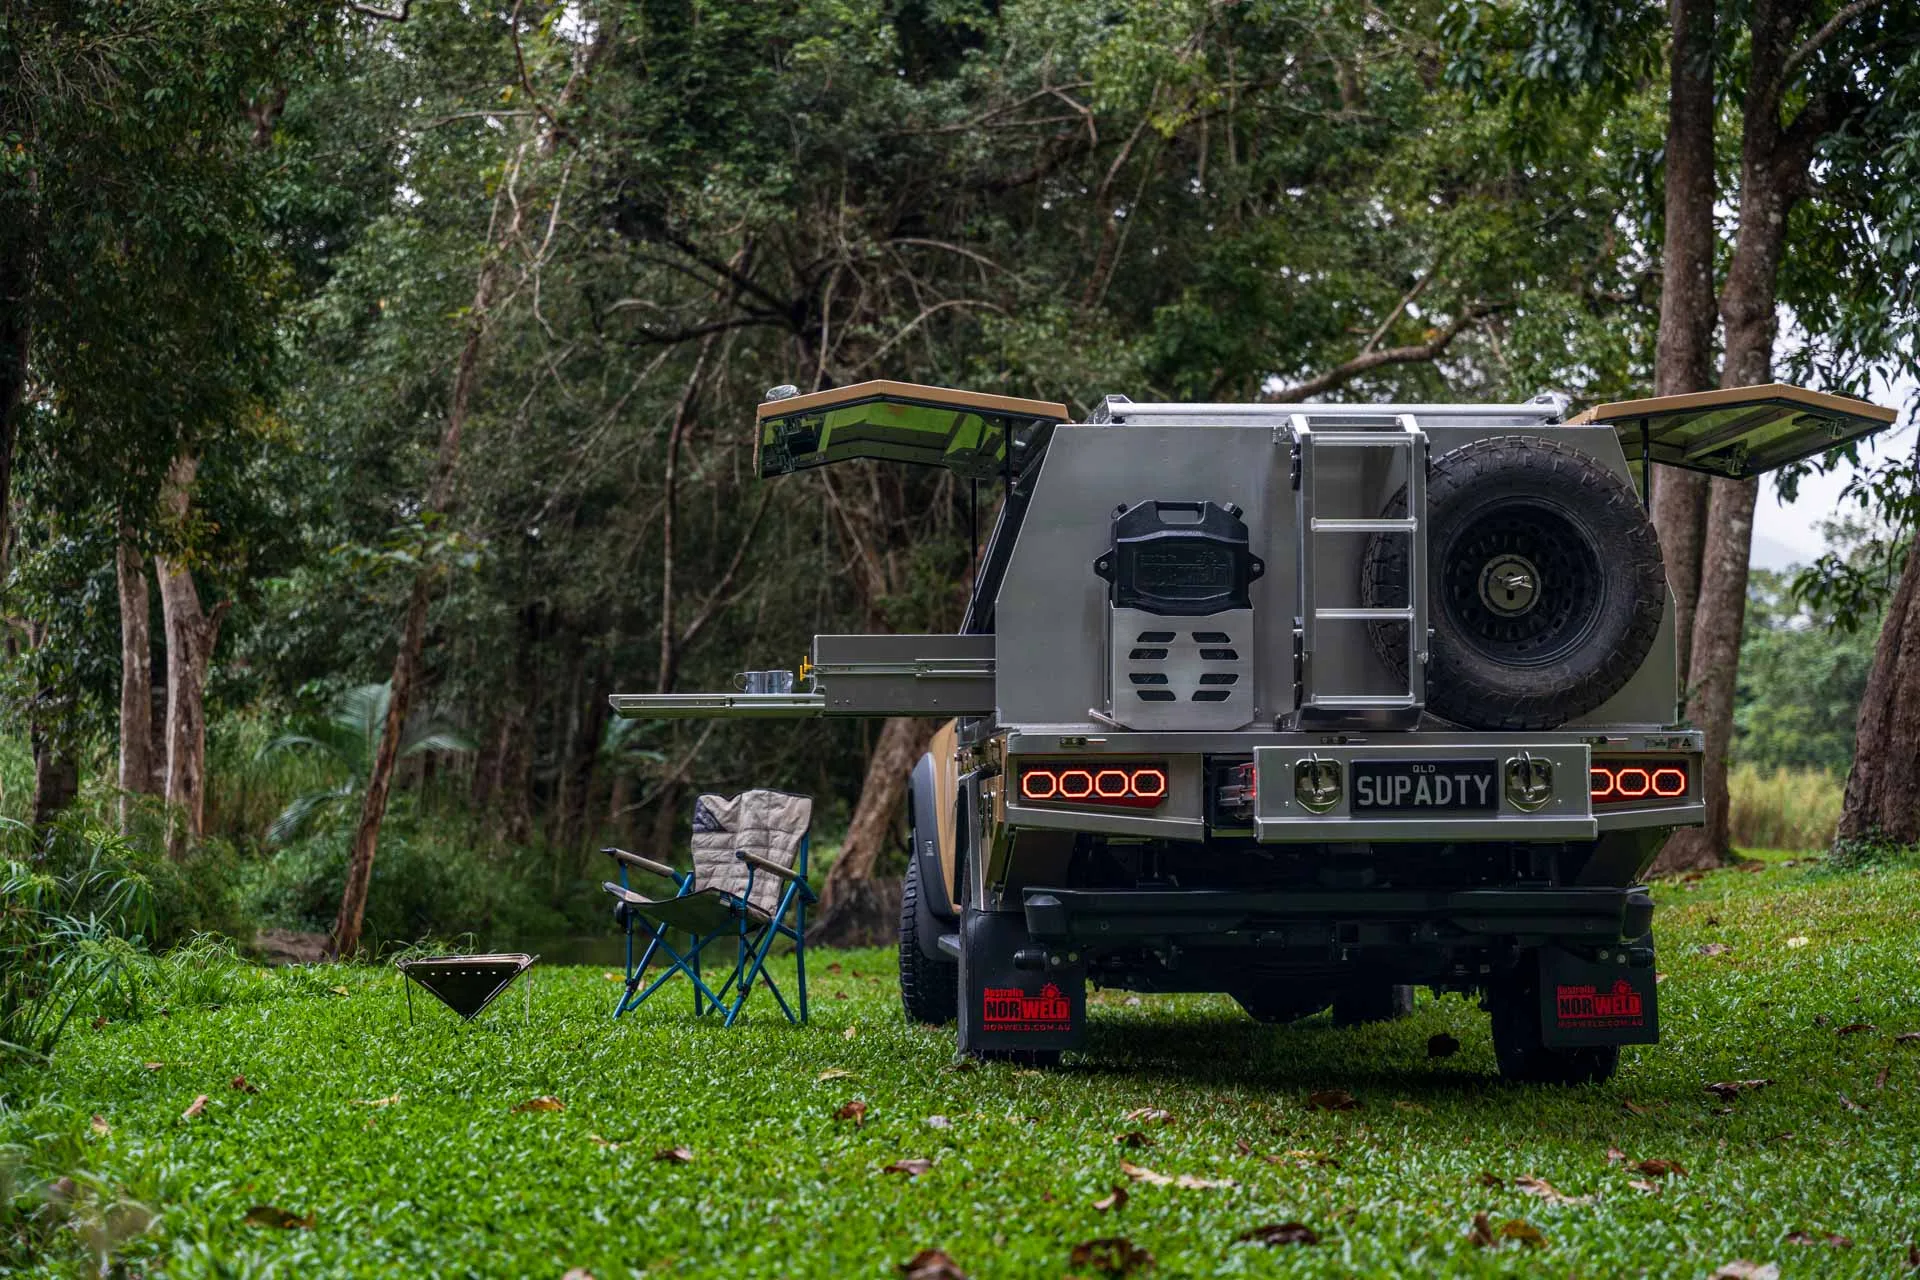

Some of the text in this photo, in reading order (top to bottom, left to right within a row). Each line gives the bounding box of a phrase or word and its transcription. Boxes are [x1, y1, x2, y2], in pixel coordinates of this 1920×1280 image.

[1412, 764, 1436, 773] QLD
[1356, 774, 1492, 806] SUPADTY
[985, 999, 1068, 1019] NORWELD
[1559, 996, 1641, 1016] NORWELD
